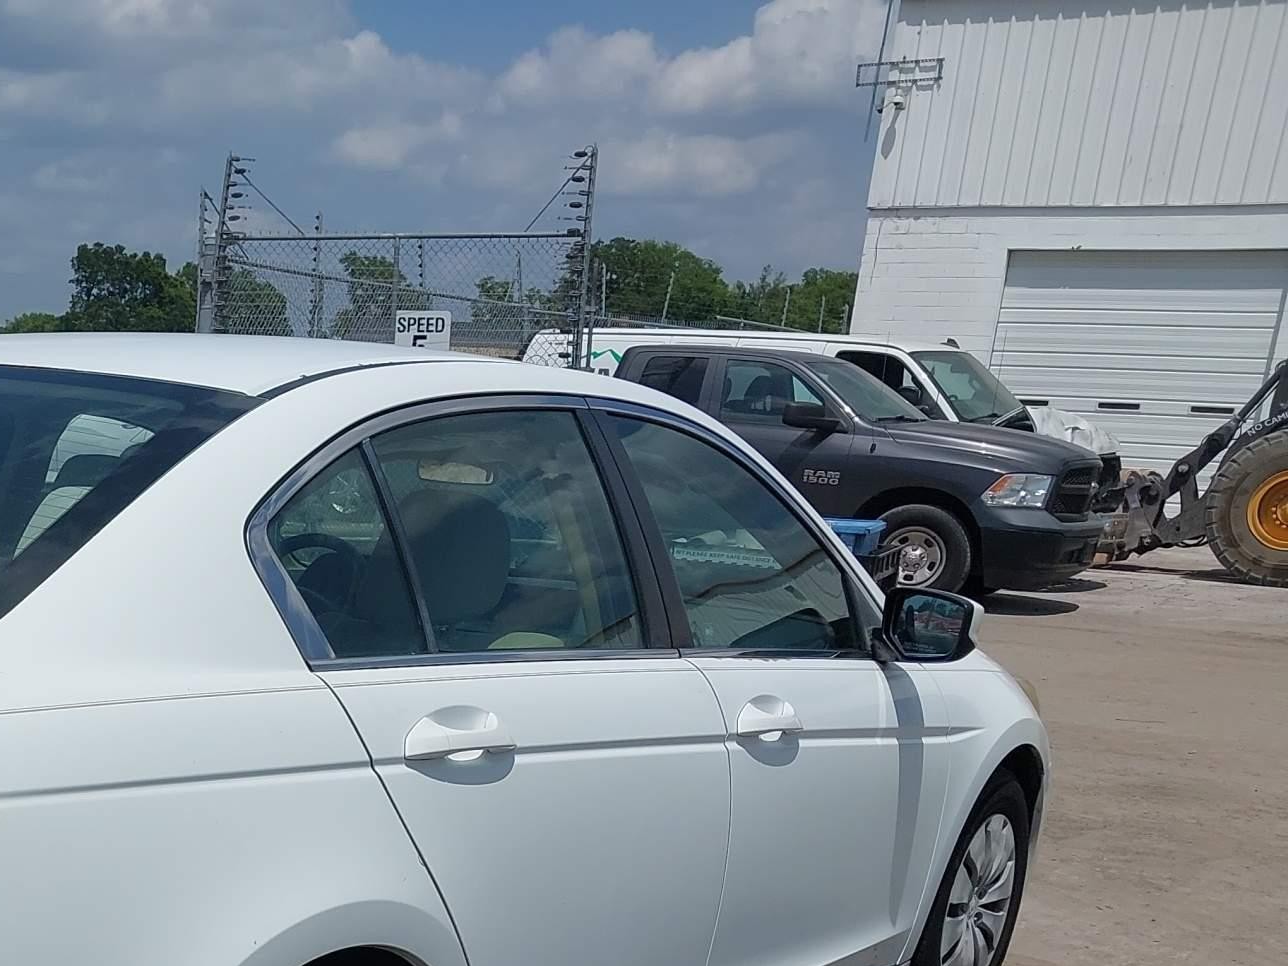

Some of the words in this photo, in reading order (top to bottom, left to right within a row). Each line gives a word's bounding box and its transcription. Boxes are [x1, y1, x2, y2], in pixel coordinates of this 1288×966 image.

[397, 317, 445, 333] SPEED
[1247, 423, 1263, 437] NO
[803, 469, 840, 479] RAM
[803, 476, 839, 485] 1500
